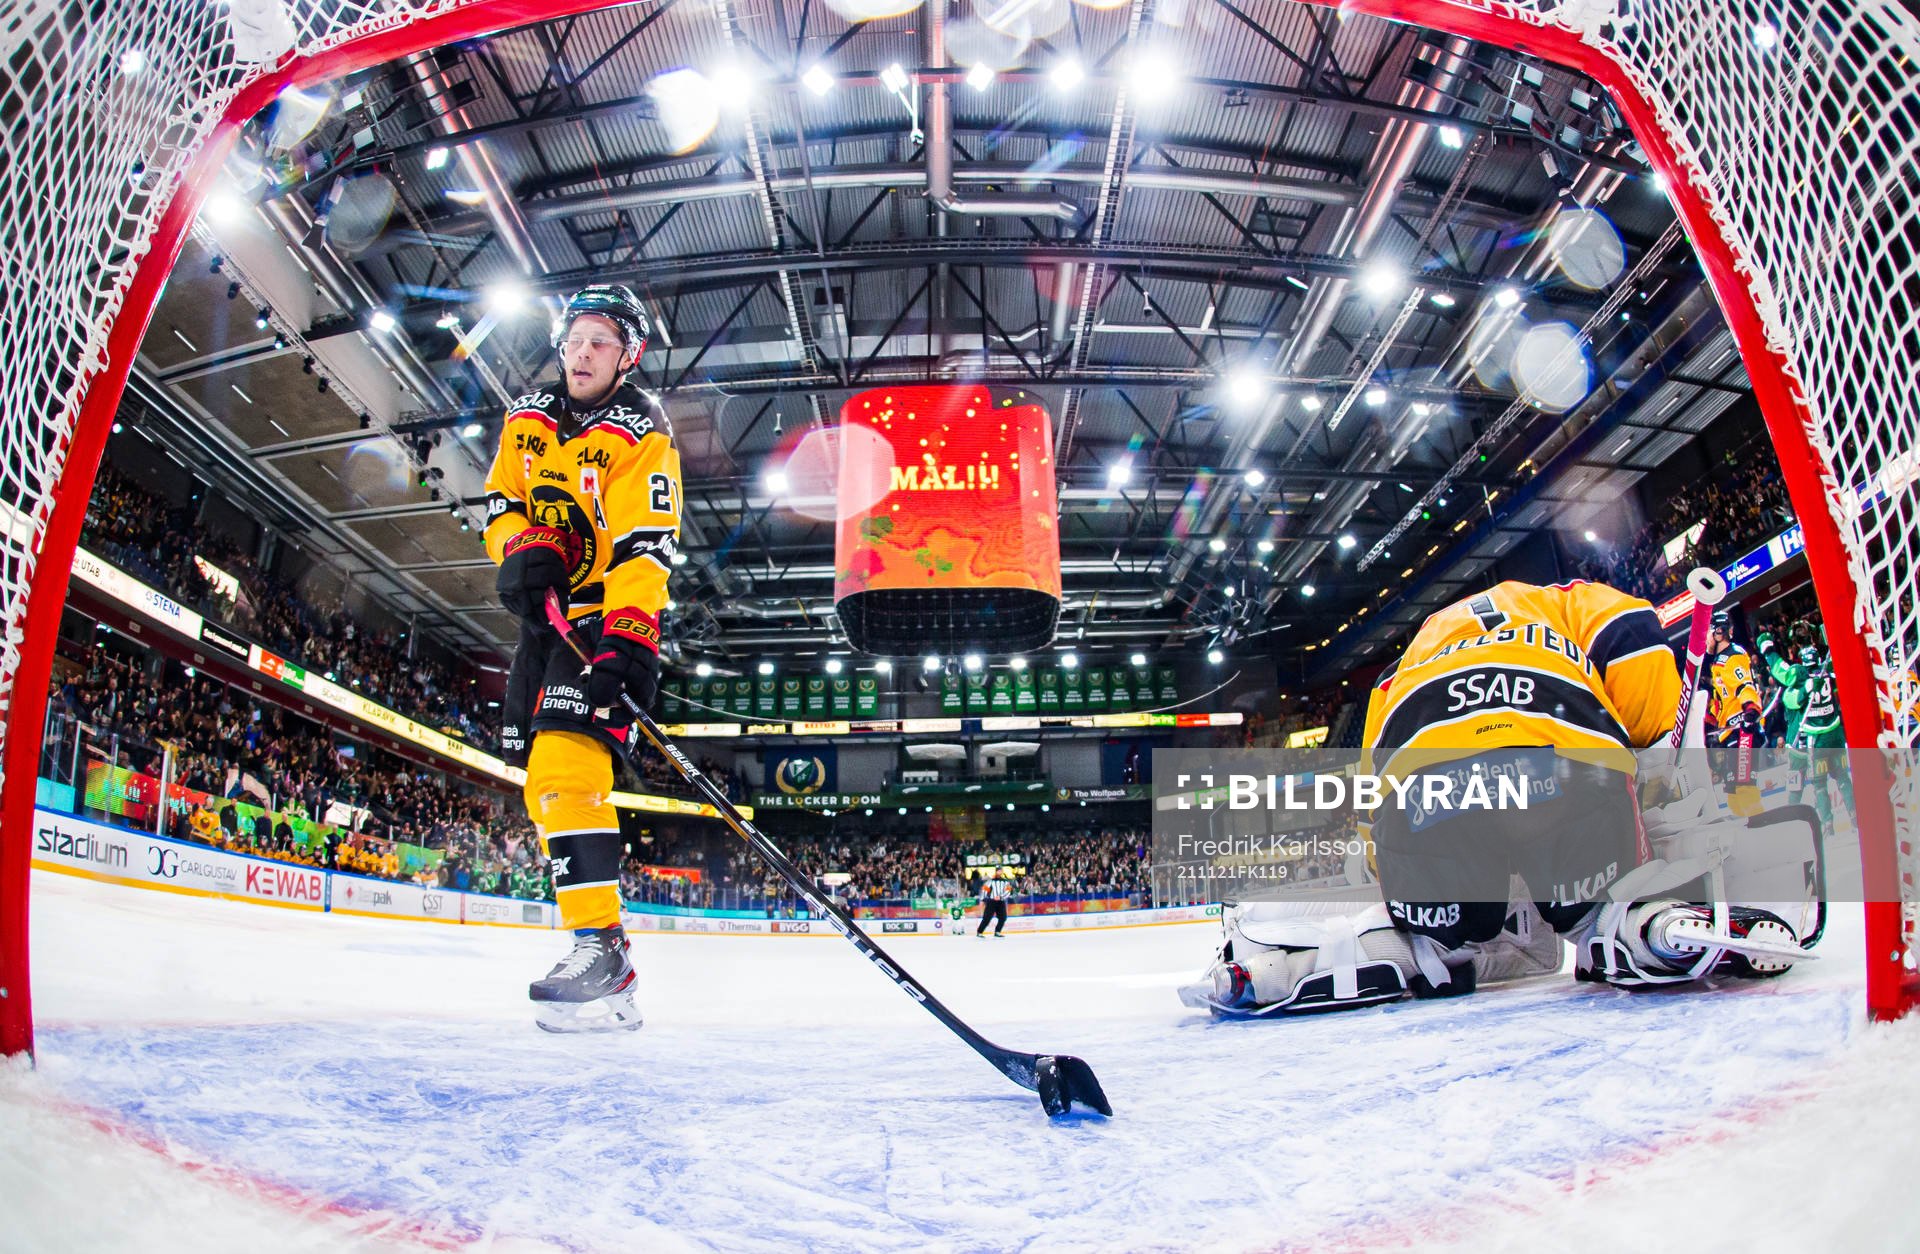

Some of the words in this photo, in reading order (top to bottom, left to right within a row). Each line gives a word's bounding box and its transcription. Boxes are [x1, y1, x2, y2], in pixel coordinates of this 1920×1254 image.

[153, 593, 181, 618] STENA
[1404, 621, 1595, 678] ALLSTEDT
[1734, 667, 1744, 681] 6
[1447, 672, 1537, 713] SSAB
[664, 743, 701, 778] BAUER
[759, 796, 783, 805] THE
[788, 796, 838, 805] LOCKER
[842, 795, 881, 805] ROOM
[1074, 790, 1089, 798] The
[1090, 788, 1126, 799] Wolfpack
[37, 825, 128, 869] stadium
[246, 863, 322, 901] KEWAB
[1560, 862, 1617, 908] LKAB
[727, 920, 762, 932] Thermia
[1406, 902, 1461, 928] LKAB
